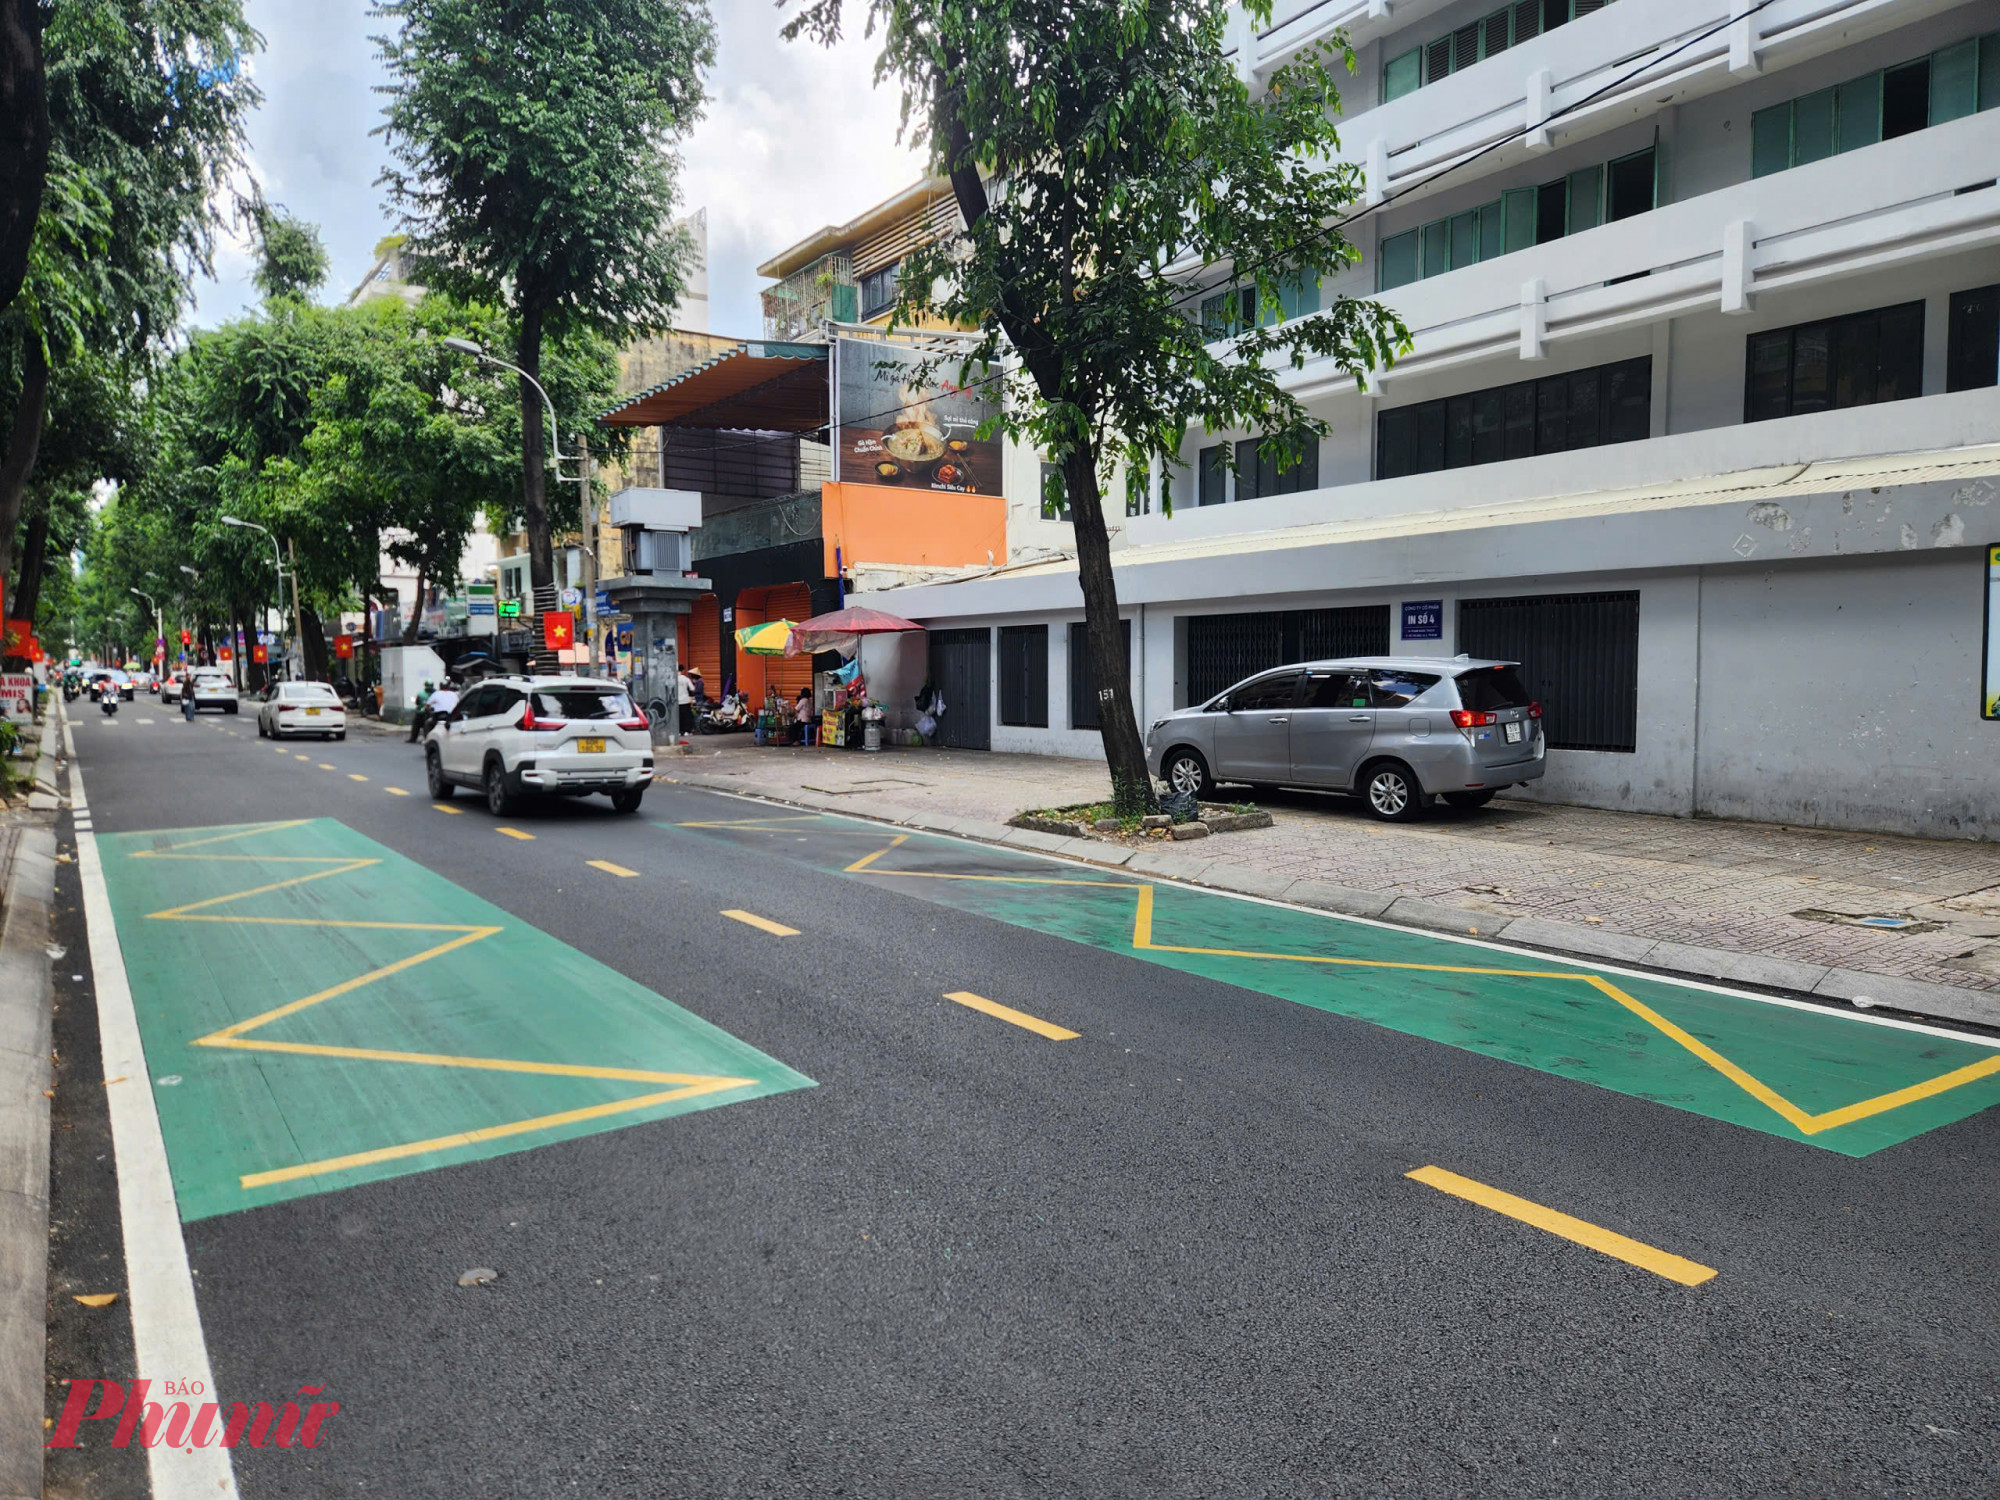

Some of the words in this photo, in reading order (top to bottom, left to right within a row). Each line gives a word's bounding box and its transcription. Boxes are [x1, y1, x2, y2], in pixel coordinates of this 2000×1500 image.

[874, 369, 889, 382] Mì
[1408, 615, 1416, 625] IN
[1417, 611, 1428, 625] SỐ
[1429, 614, 1434, 624] 4
[8, 677, 30, 686] KHOA
[1098, 688, 1114, 701] 151
